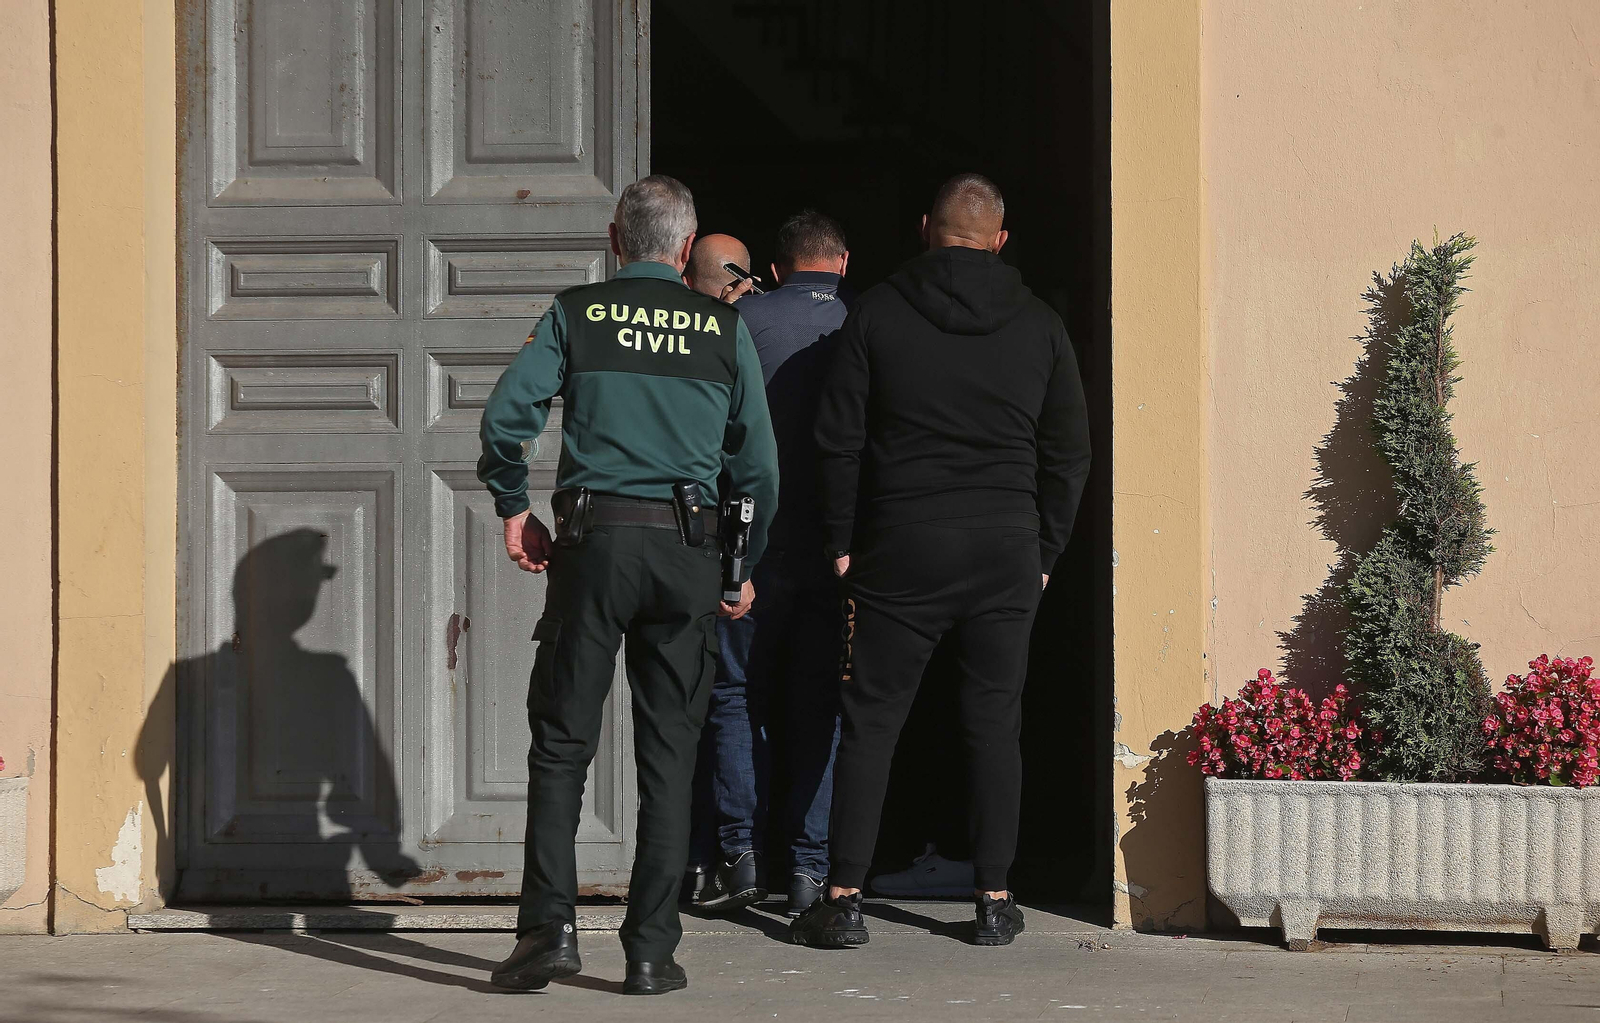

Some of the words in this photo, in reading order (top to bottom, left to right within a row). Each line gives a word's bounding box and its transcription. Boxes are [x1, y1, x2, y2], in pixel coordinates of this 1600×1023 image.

[811, 291, 836, 300] BOSS
[586, 303, 721, 336] GUARDIA
[617, 328, 691, 355] CIVIL
